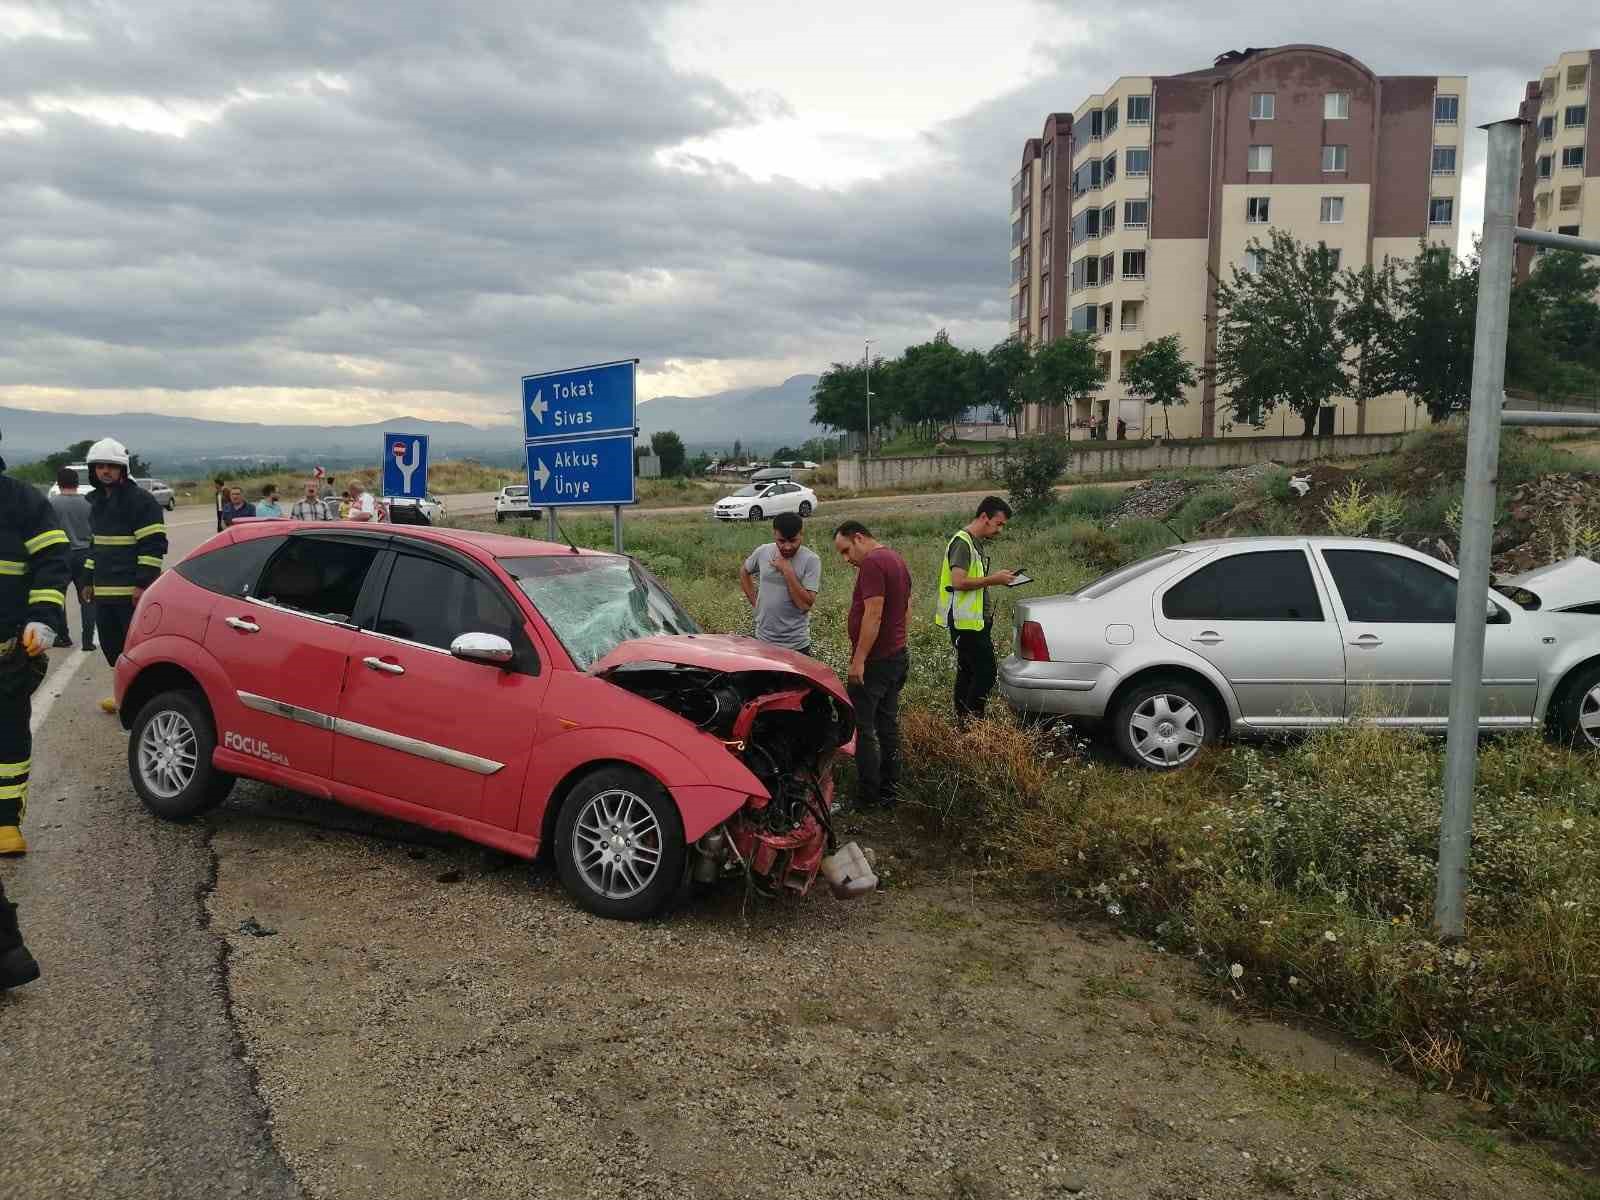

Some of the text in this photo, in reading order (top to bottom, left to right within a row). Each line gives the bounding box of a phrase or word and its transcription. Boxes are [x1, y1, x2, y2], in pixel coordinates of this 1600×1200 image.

[553, 380, 594, 400] Tokat
[554, 409, 593, 427] Sivas
[555, 451, 598, 468] Akkuş
[555, 475, 590, 497] Ünye
[224, 731, 272, 759] FOCUS
